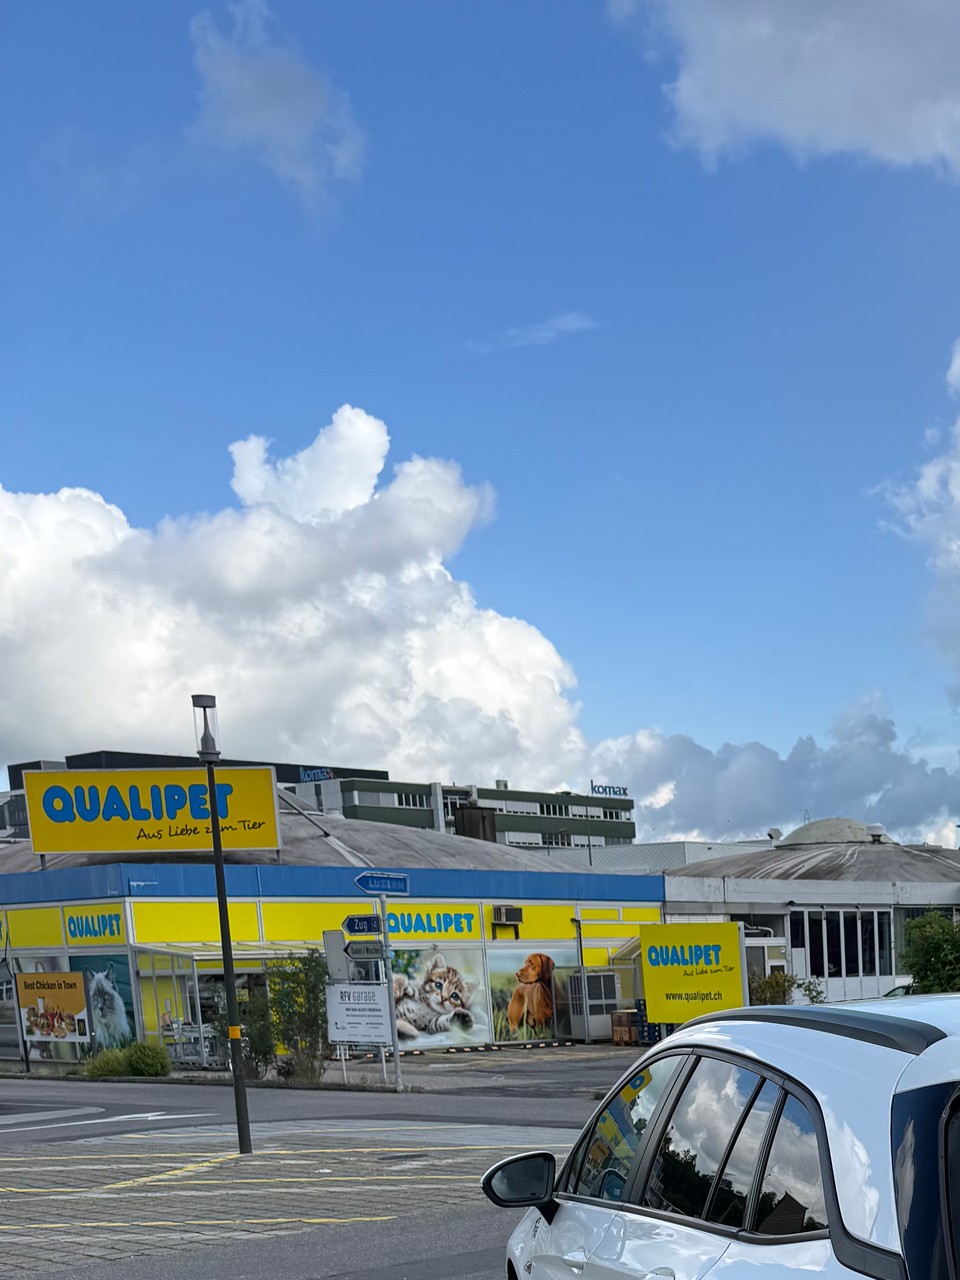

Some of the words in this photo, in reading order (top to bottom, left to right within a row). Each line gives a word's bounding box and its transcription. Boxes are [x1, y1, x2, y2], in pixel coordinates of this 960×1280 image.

[300, 766, 334, 782] komax
[590, 779, 629, 797] komax
[42, 783, 233, 824] QUALIPET
[136, 829, 163, 841] Aus
[168, 824, 200, 837] Liebe
[204, 822, 237, 834] zm
[238, 820, 266, 831] Tier
[67, 913, 121, 939] QUALIPET
[354, 918, 368, 932] Zug
[386, 912, 474, 933] QUALIPET
[647, 944, 721, 967] QUALIPET
[683, 969, 694, 977] Aus
[23, 980, 36, 990] Best
[35, 980, 57, 990] Chicken
[56, 980, 63, 990] in
[62, 980, 77, 990] Town
[664, 990, 723, 1003] www.qualipet.ch
